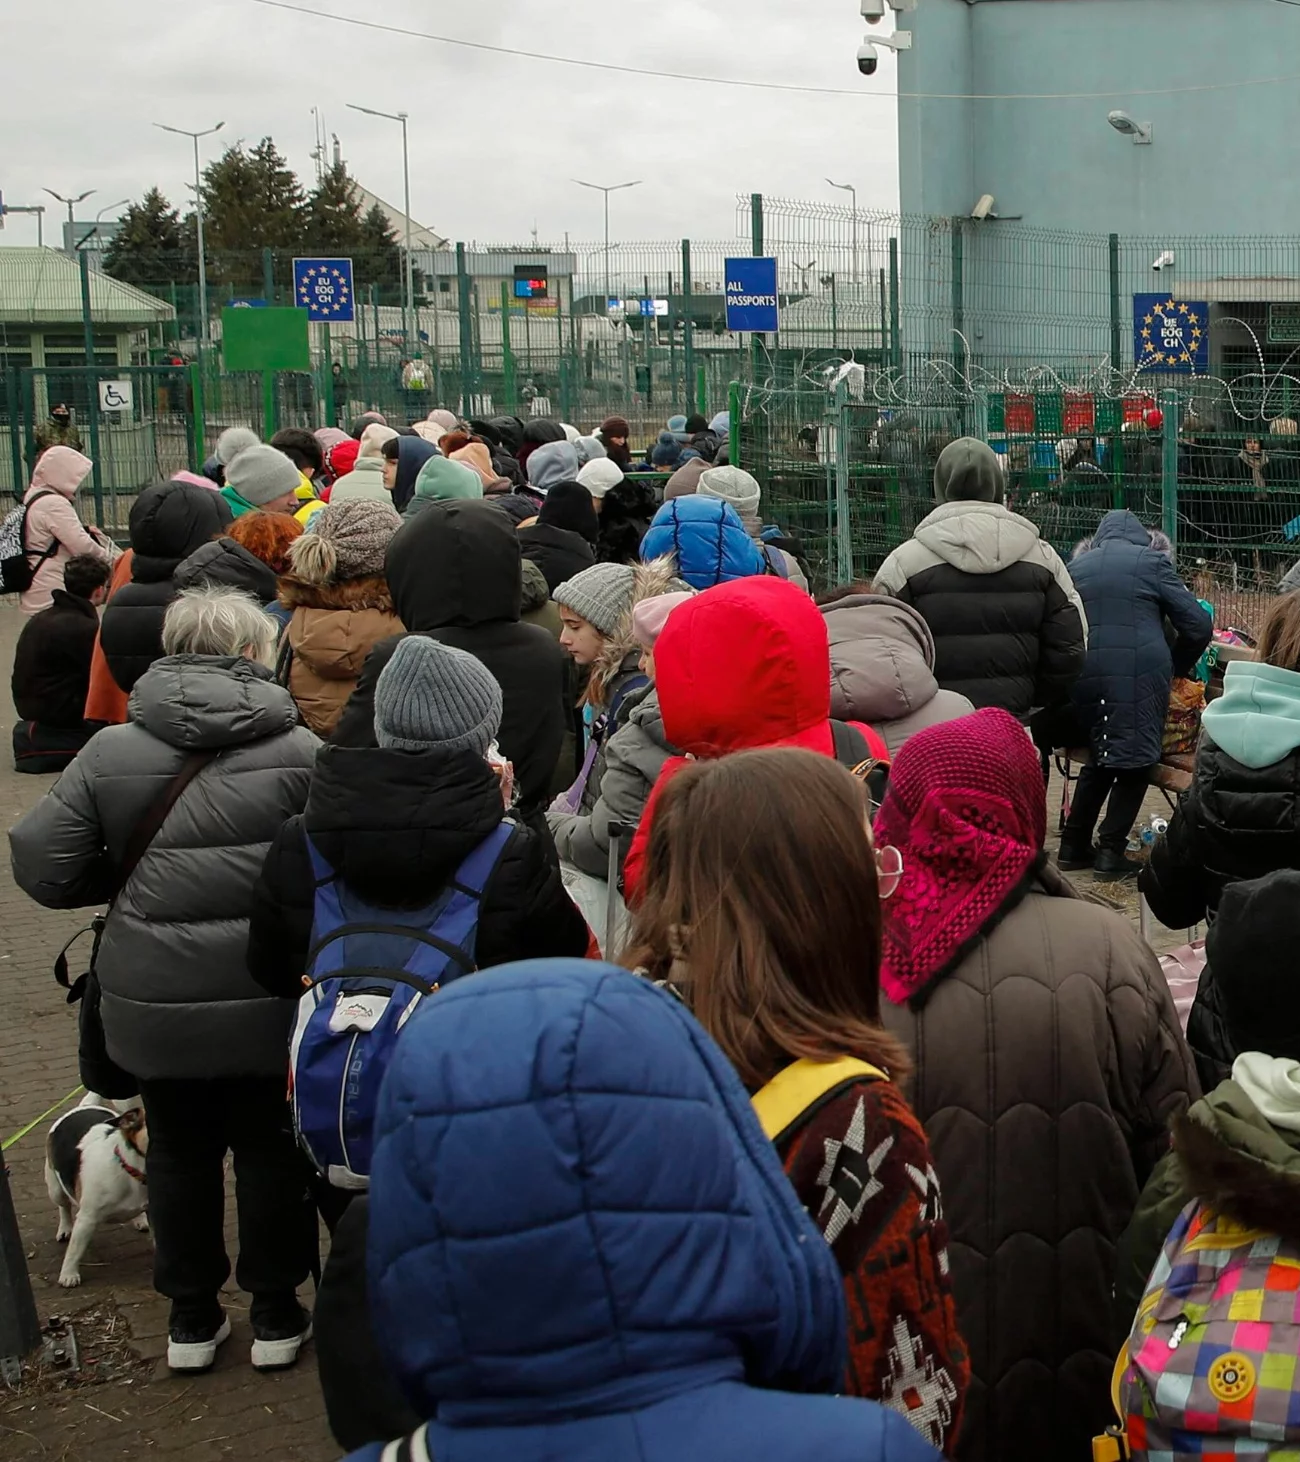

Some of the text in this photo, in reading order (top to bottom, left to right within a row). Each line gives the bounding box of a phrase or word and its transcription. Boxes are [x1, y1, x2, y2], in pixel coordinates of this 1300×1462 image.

[315, 286, 334, 294] EOG
[727, 281, 744, 292] ALL
[318, 295, 332, 303] CH
[727, 295, 776, 306] PASSPORTS
[1164, 318, 1177, 327] UE
[1161, 328, 1183, 337] EOG
[1164, 339, 1178, 347] CH
